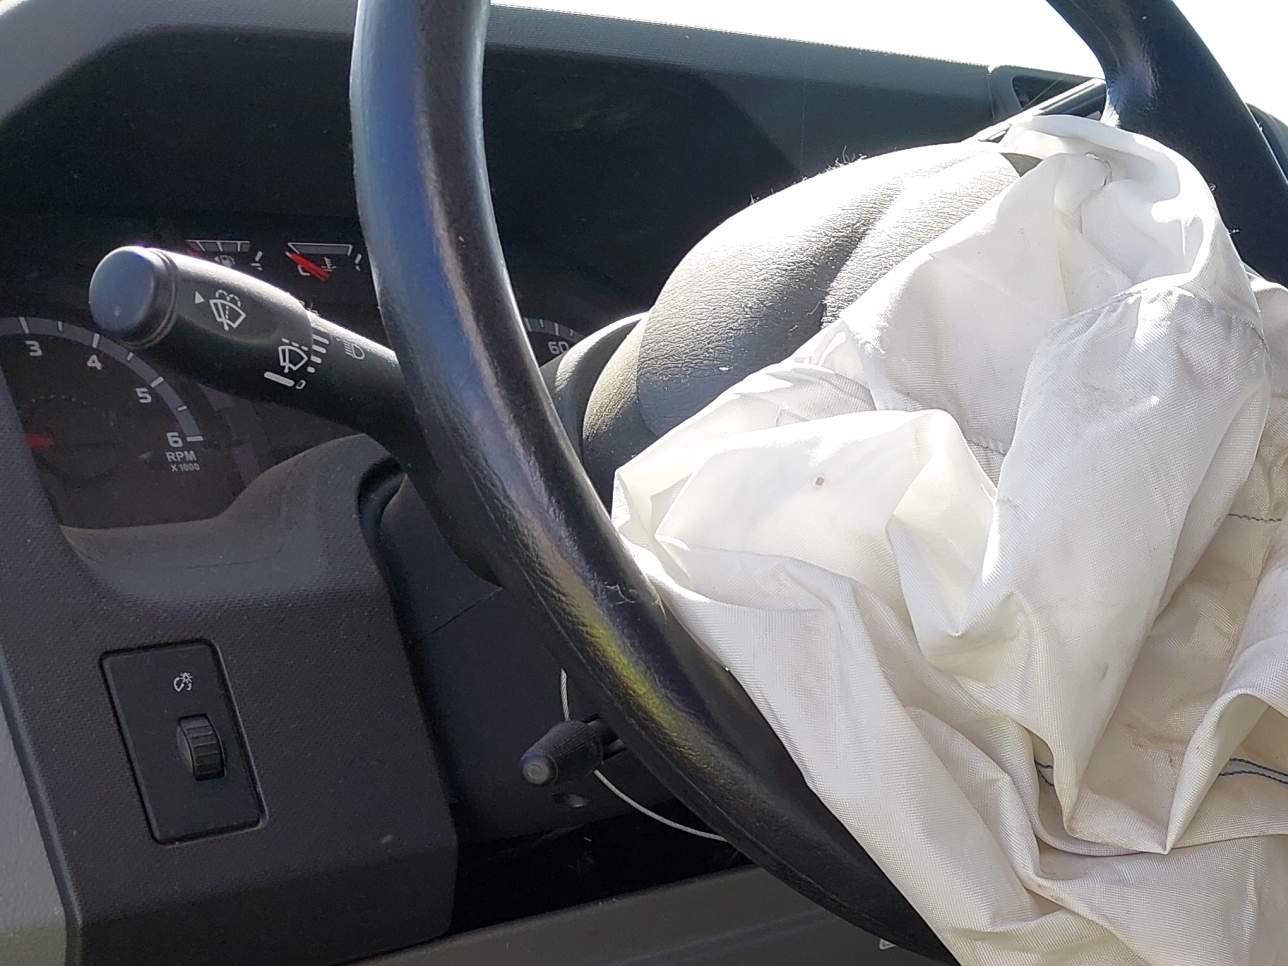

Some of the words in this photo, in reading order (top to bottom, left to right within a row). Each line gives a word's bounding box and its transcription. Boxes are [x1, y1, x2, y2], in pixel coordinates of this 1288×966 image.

[25, 340, 43, 357] 3
[548, 341, 569, 355] 60
[86, 354, 103, 371] 4
[135, 387, 152, 404] 5
[166, 432, 183, 448] 6
[165, 450, 197, 463] RPM
